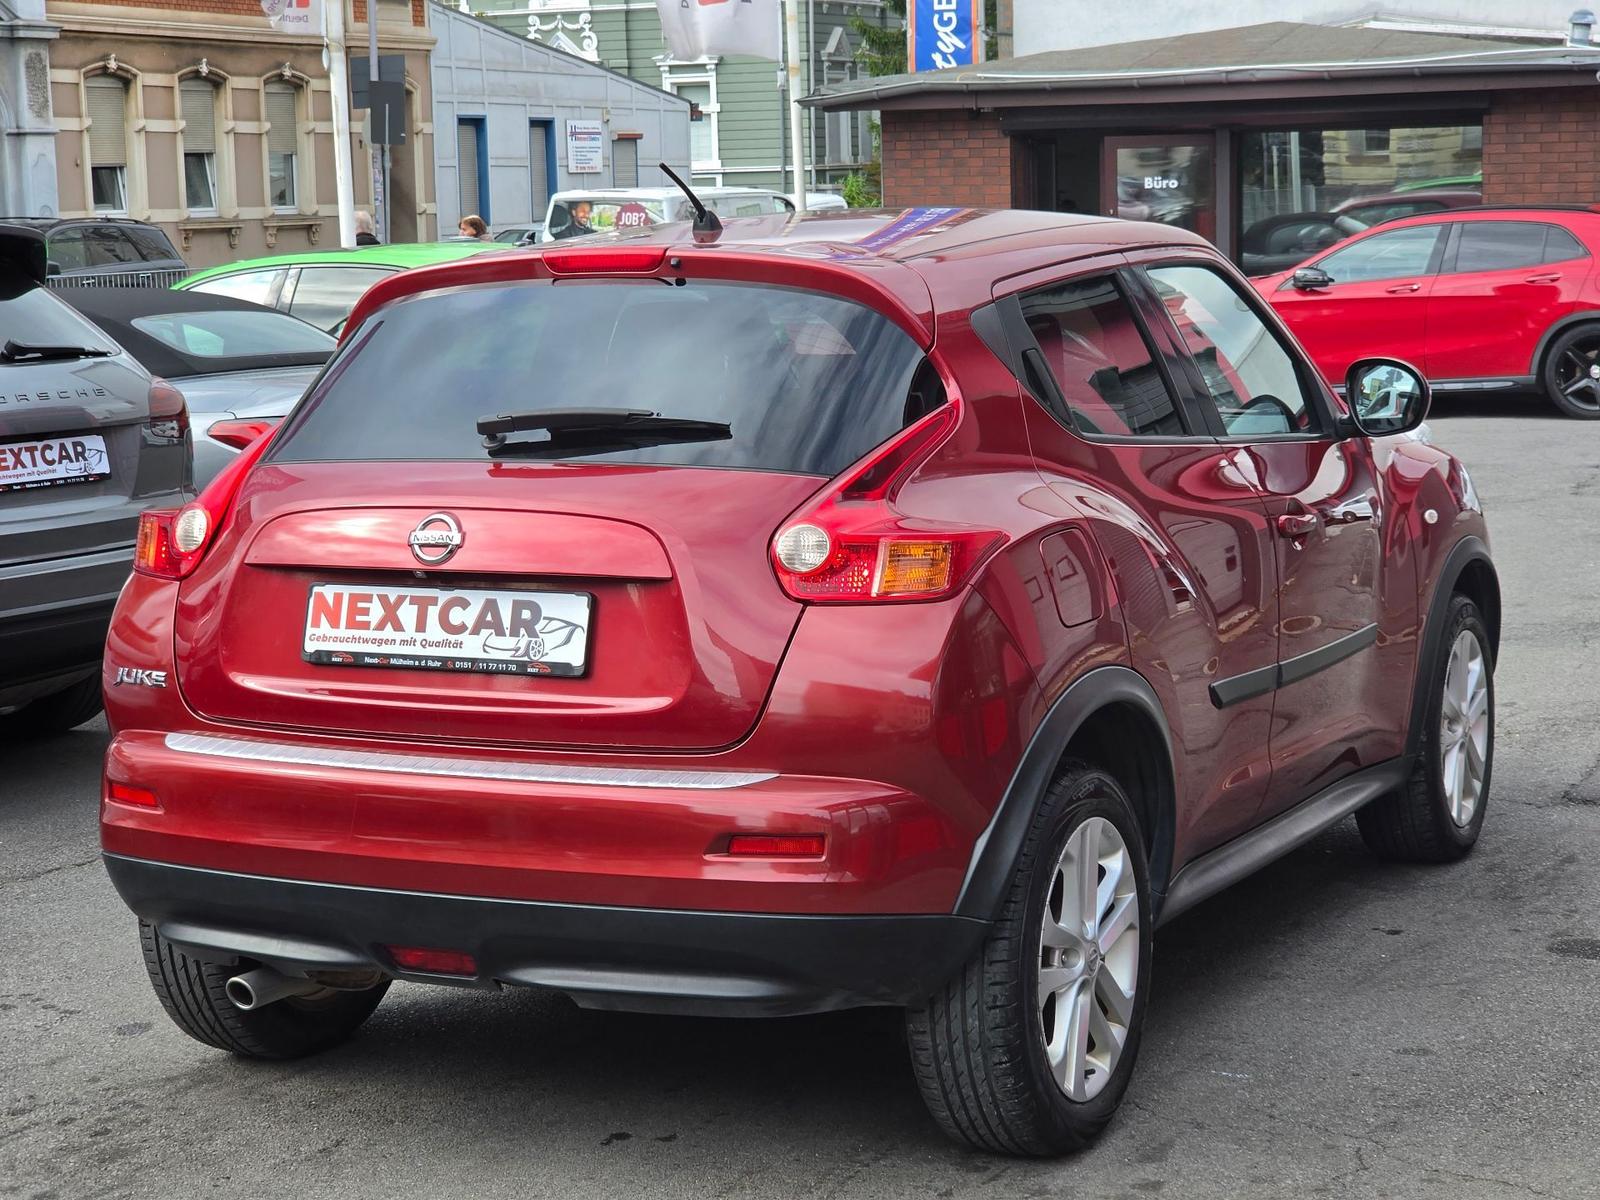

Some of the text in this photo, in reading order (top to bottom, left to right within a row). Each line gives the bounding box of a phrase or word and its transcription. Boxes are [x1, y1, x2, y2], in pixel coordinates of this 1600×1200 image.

[1144, 176, 1179, 189] Büro
[618, 212, 646, 226] JOB?
[413, 534, 454, 543] NISSAN
[310, 591, 543, 638] NEXTCAR
[308, 633, 464, 650] Gebrauchtwagen mit Qualität
[455, 661, 471, 669] 0151
[112, 666, 167, 688] JUKE
